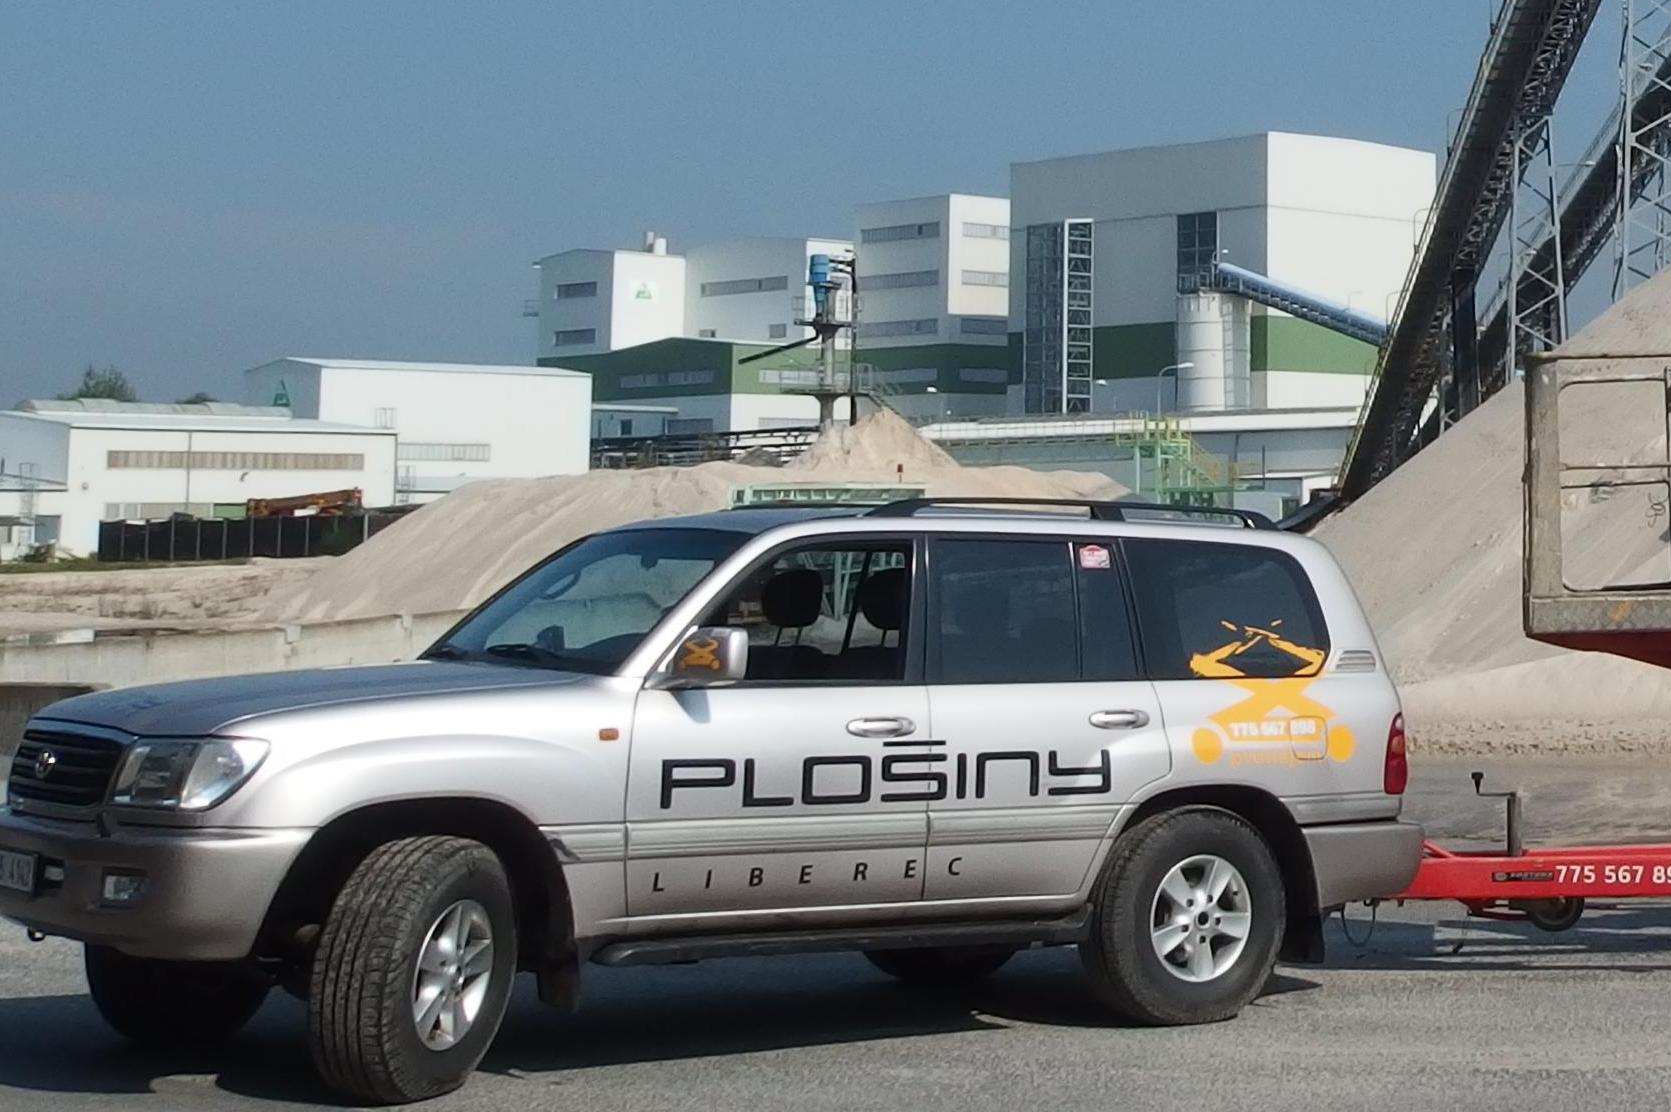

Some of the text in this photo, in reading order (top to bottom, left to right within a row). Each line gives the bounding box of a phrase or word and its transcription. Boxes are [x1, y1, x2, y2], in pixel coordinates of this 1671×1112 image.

[653, 857, 963, 892] LIBEREC
[1555, 865, 1596, 884] 775
[1604, 865, 1645, 884] 567
